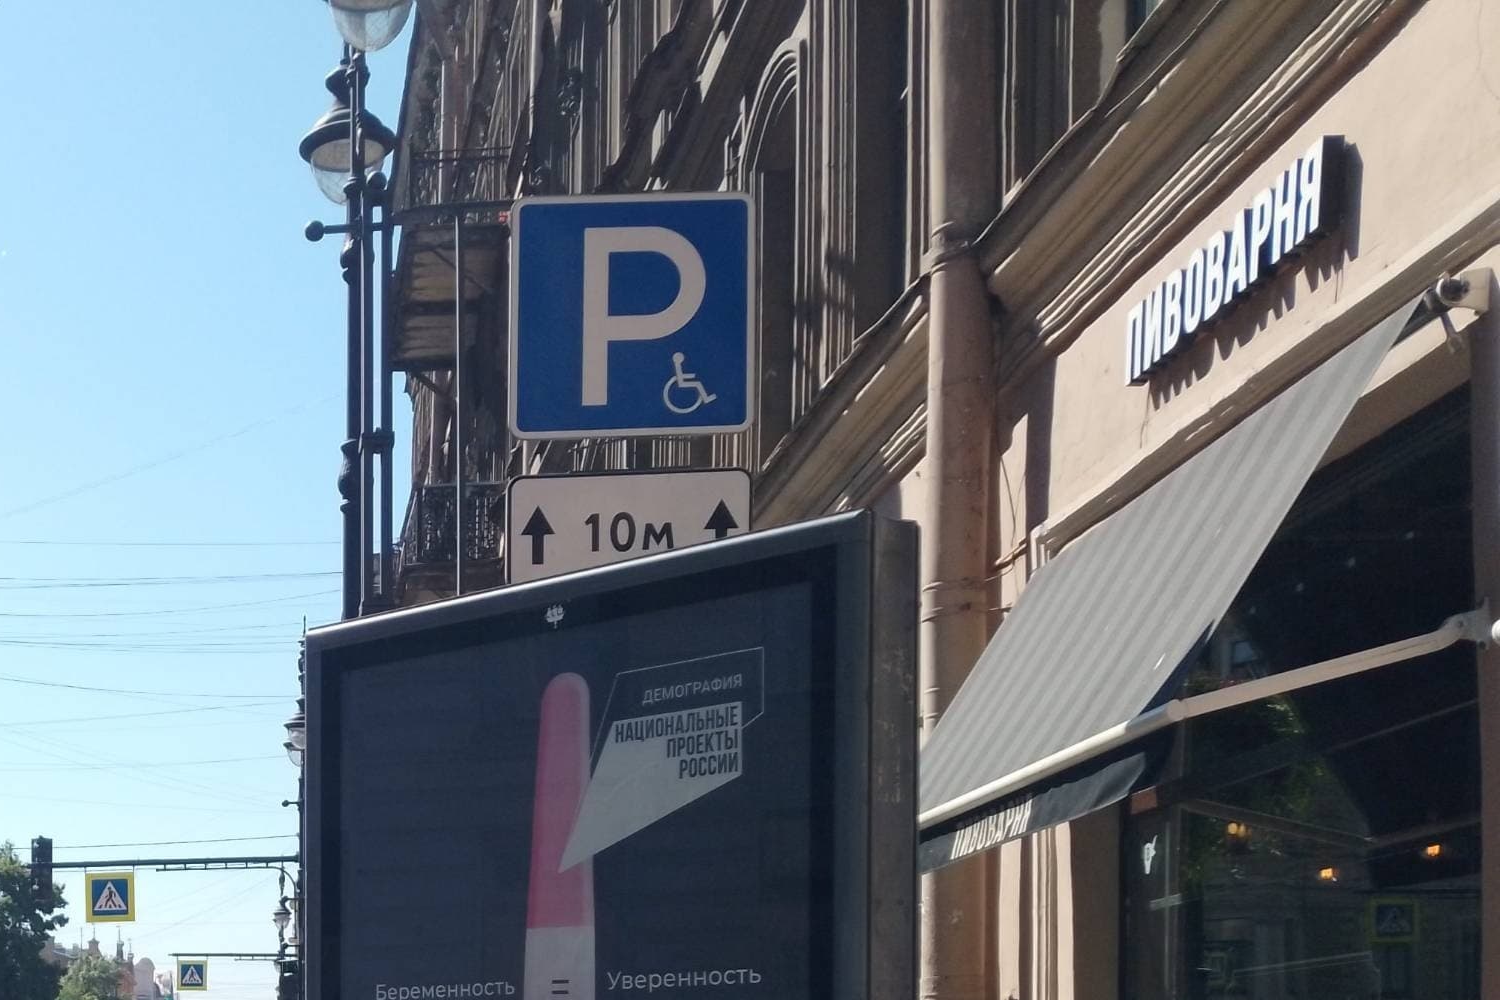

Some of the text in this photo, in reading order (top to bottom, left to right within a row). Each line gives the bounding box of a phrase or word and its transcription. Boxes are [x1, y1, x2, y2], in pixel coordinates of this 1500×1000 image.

[1126, 135, 1324, 386] ПИВОВАРНЯ
[582, 226, 706, 406] P
[642, 673, 743, 706] ДЕМОГРАФИЯ
[614, 705, 739, 744] НАЦИОНАЛЬНЫЕ
[666, 728, 739, 758] ПРОЕКТЫ
[678, 751, 739, 780] РОССИИ
[607, 967, 762, 993] Уверенность
